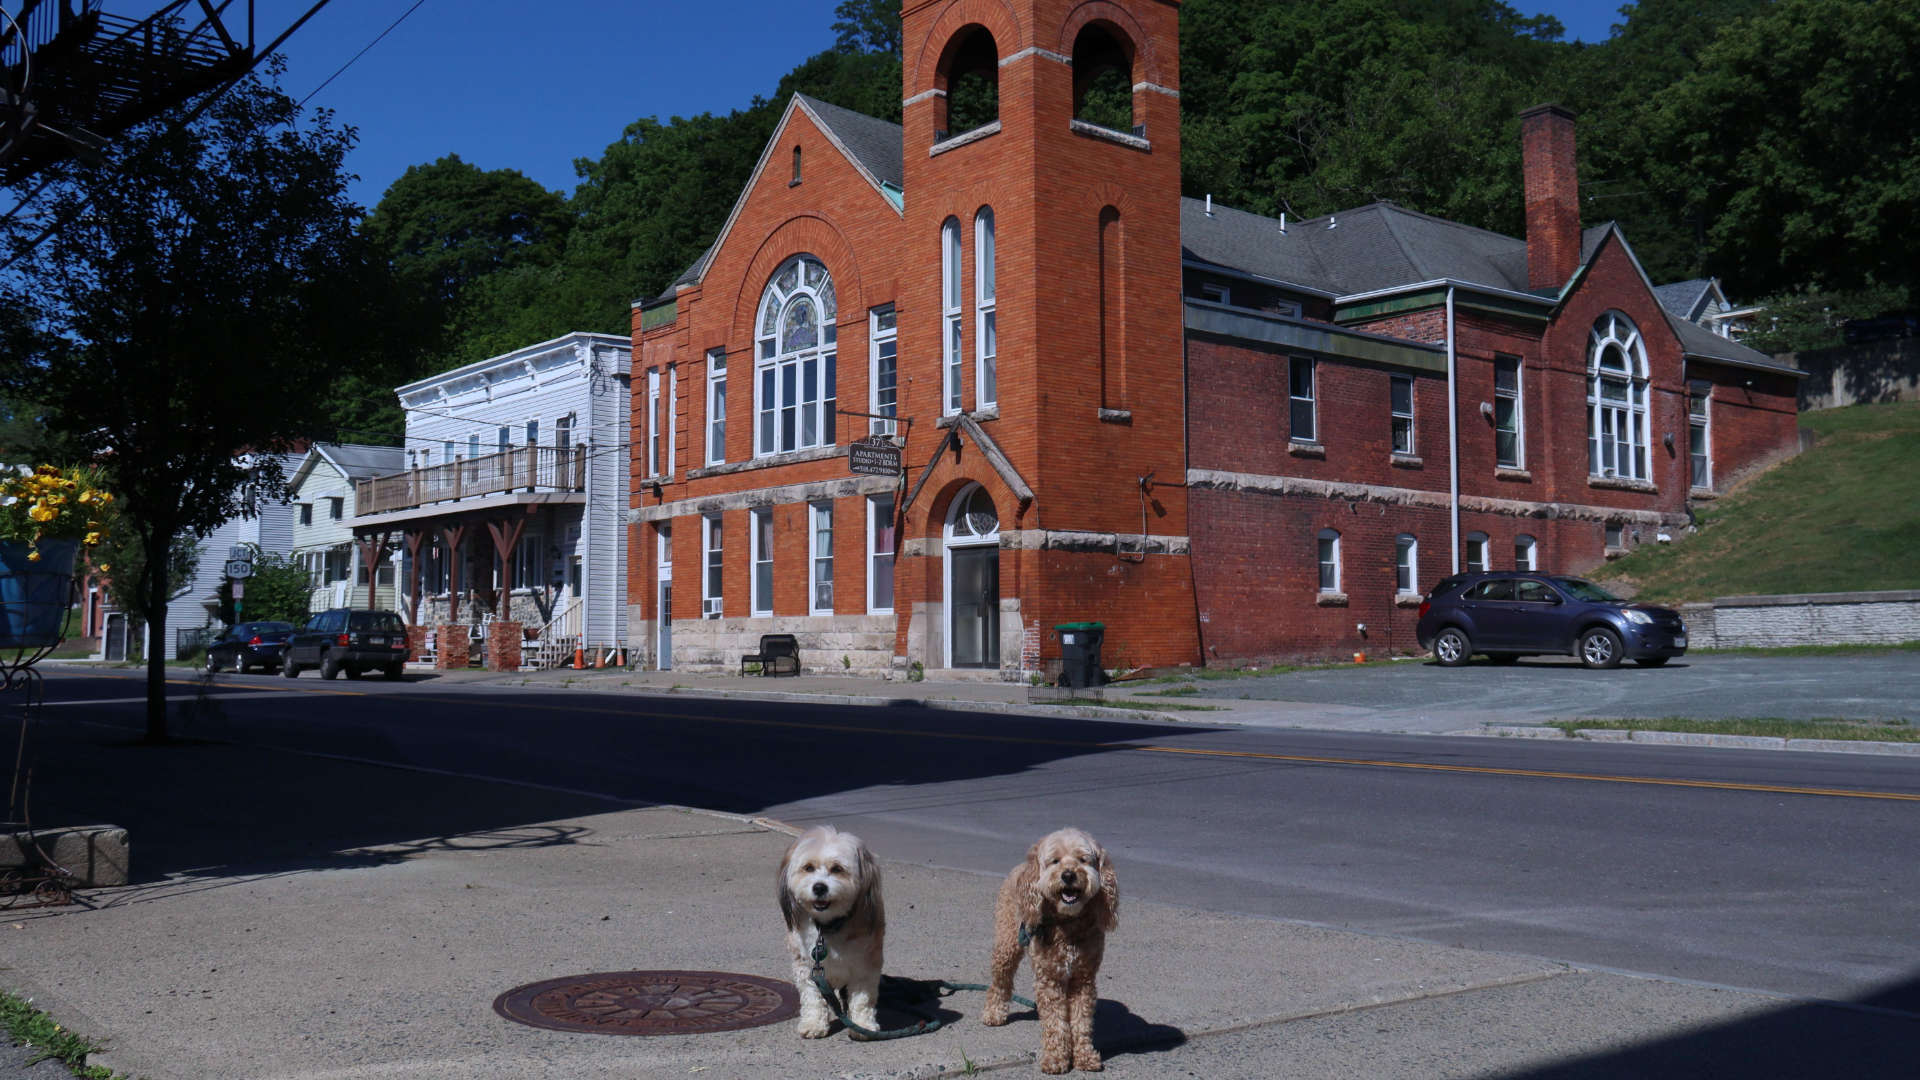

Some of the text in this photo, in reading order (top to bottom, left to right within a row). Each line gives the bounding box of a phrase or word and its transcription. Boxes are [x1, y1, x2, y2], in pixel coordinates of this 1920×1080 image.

[871, 437, 881, 447] 37
[855, 450, 897, 460] APARTMENTS
[231, 549, 247, 558] JCT
[229, 564, 248, 574] 150
